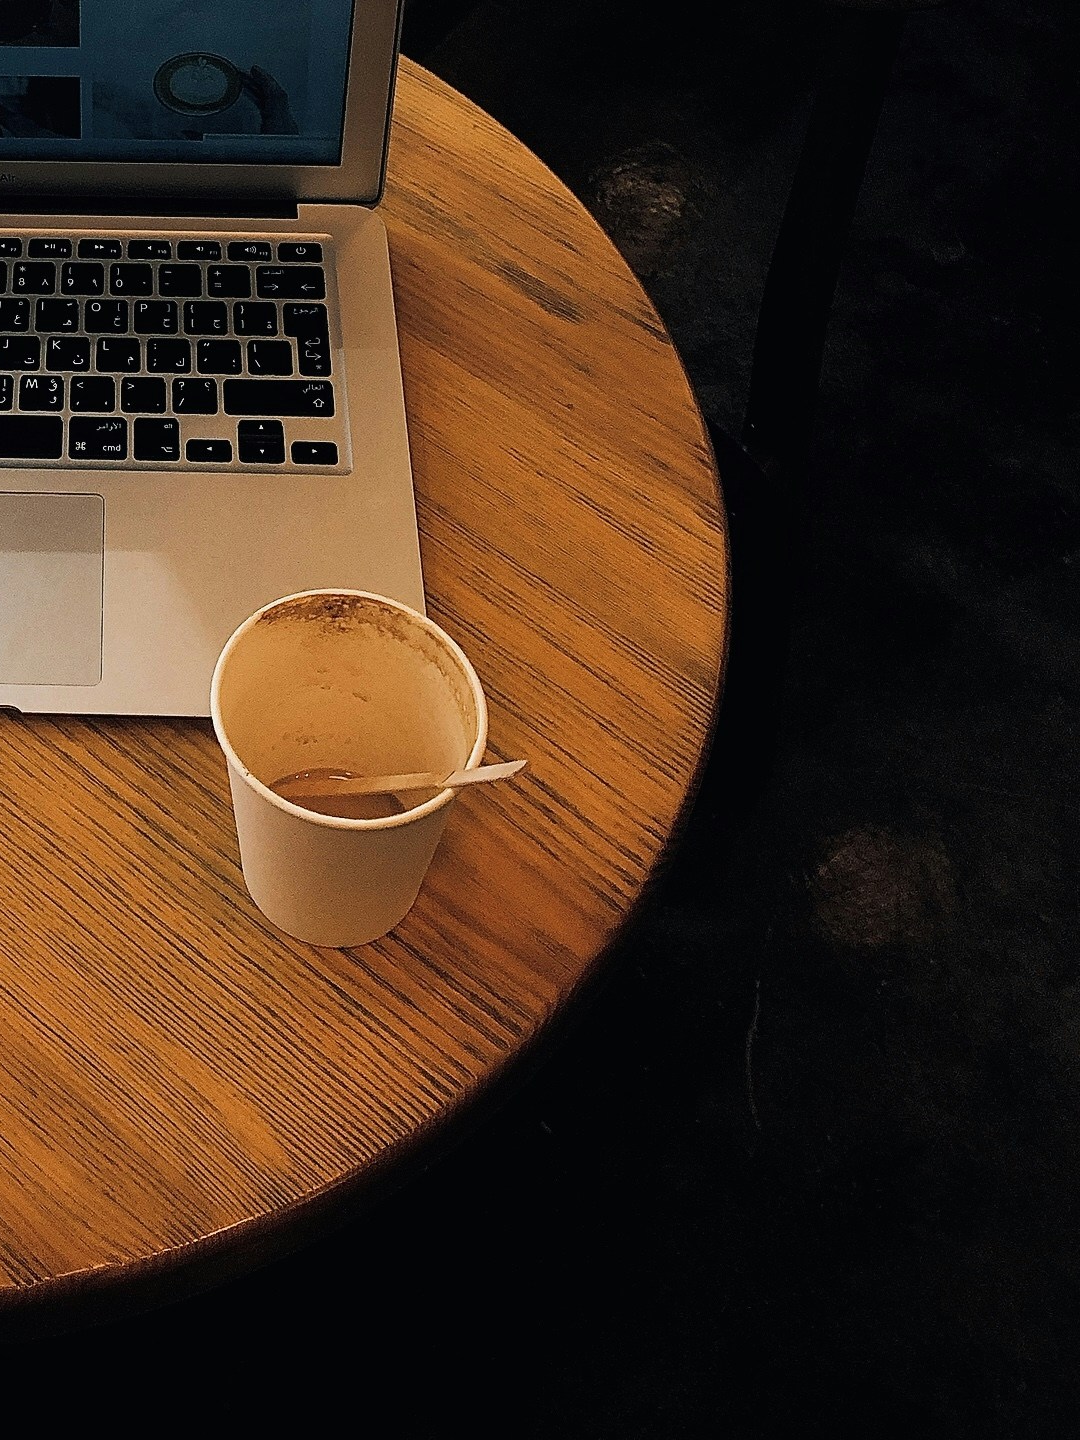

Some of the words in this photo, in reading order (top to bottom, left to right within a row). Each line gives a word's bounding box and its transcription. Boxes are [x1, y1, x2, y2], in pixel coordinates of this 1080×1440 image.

[0, 174, 16, 182] Air
[18, 277, 25, 286] 8
[68, 278, 74, 286] 9
[140, 304, 148, 312] P
[3, 339, 9, 348] J
[53, 340, 61, 350] K
[103, 341, 109, 351] L
[26, 379, 38, 388] M
